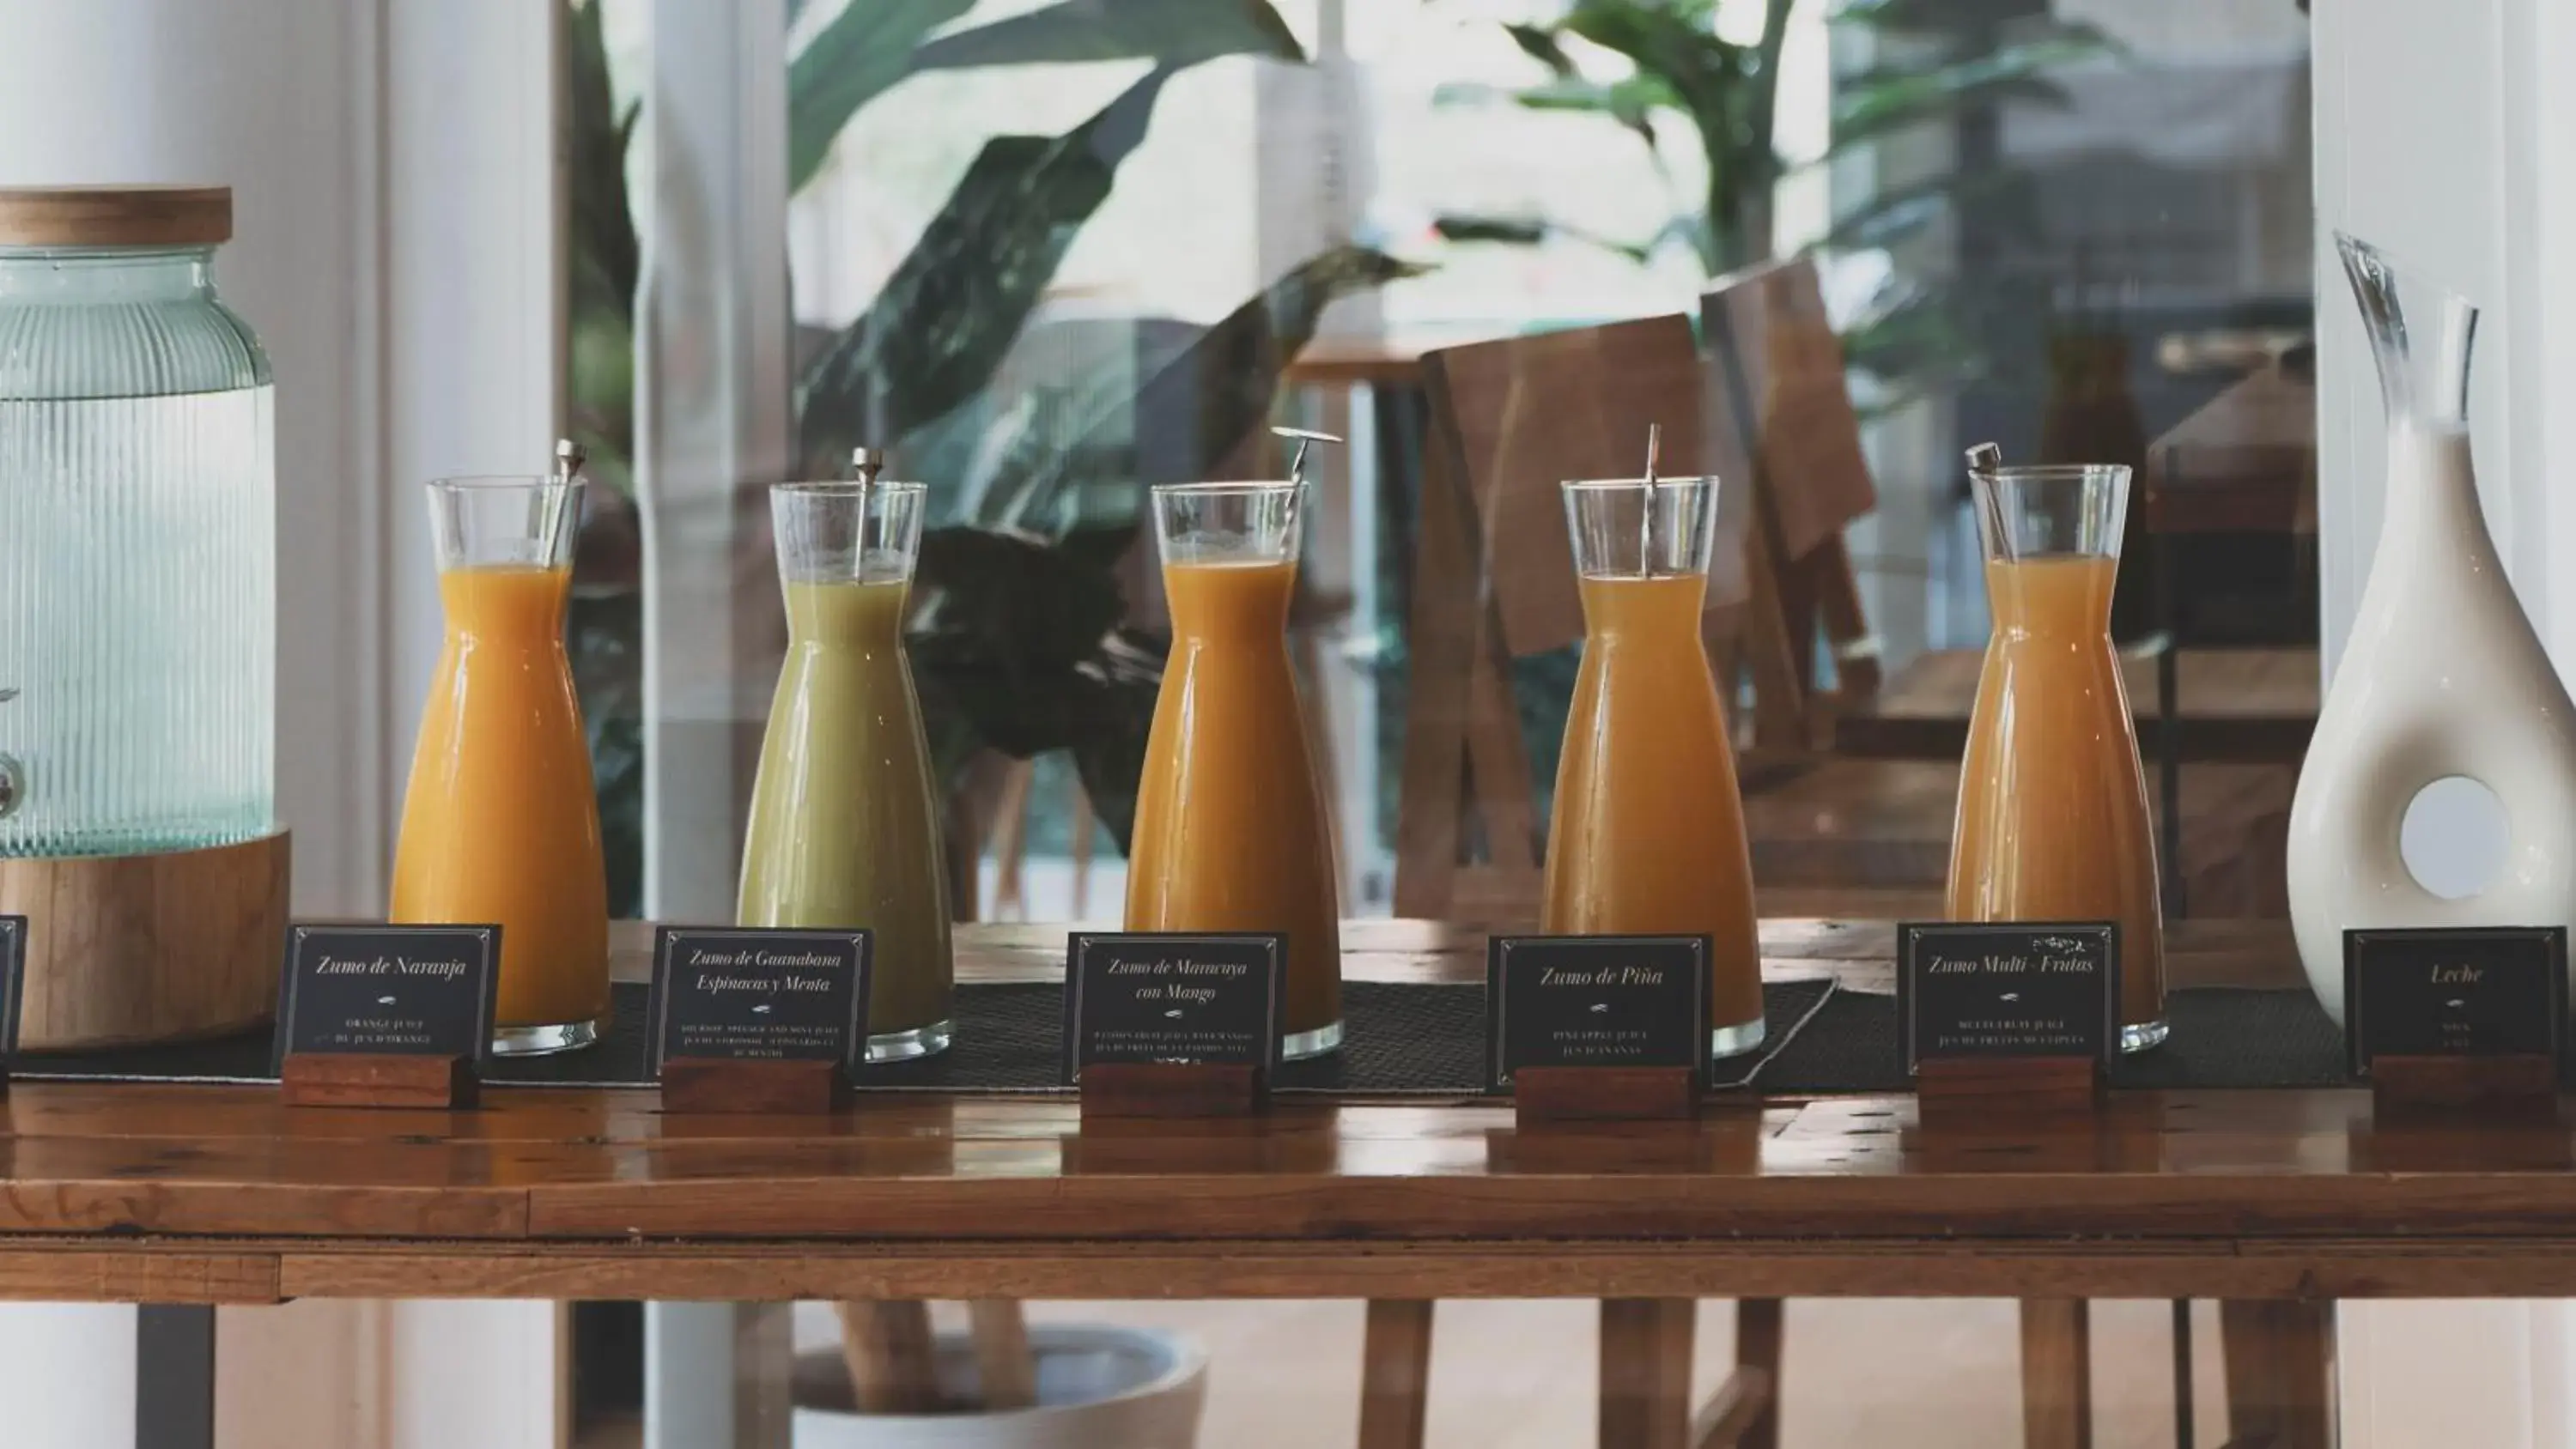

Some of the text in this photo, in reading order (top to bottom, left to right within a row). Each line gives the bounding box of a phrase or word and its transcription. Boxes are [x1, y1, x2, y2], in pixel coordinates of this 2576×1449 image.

[690, 949, 732, 967] Zumo
[734, 949, 753, 967] de
[1107, 958, 1151, 975] Zumo
[1153, 958, 1172, 975] de
[1929, 955, 1978, 974] Zumo
[1982, 955, 2028, 973] Multi
[2040, 955, 2093, 973] Frutas
[315, 955, 467, 982] Zumo de Naranja
[1540, 963, 1664, 985] Zumo de Piña
[2431, 963, 2484, 984] Leche
[696, 974, 832, 995] Espinacas y Menta
[1135, 984, 1217, 1003] con Mango
